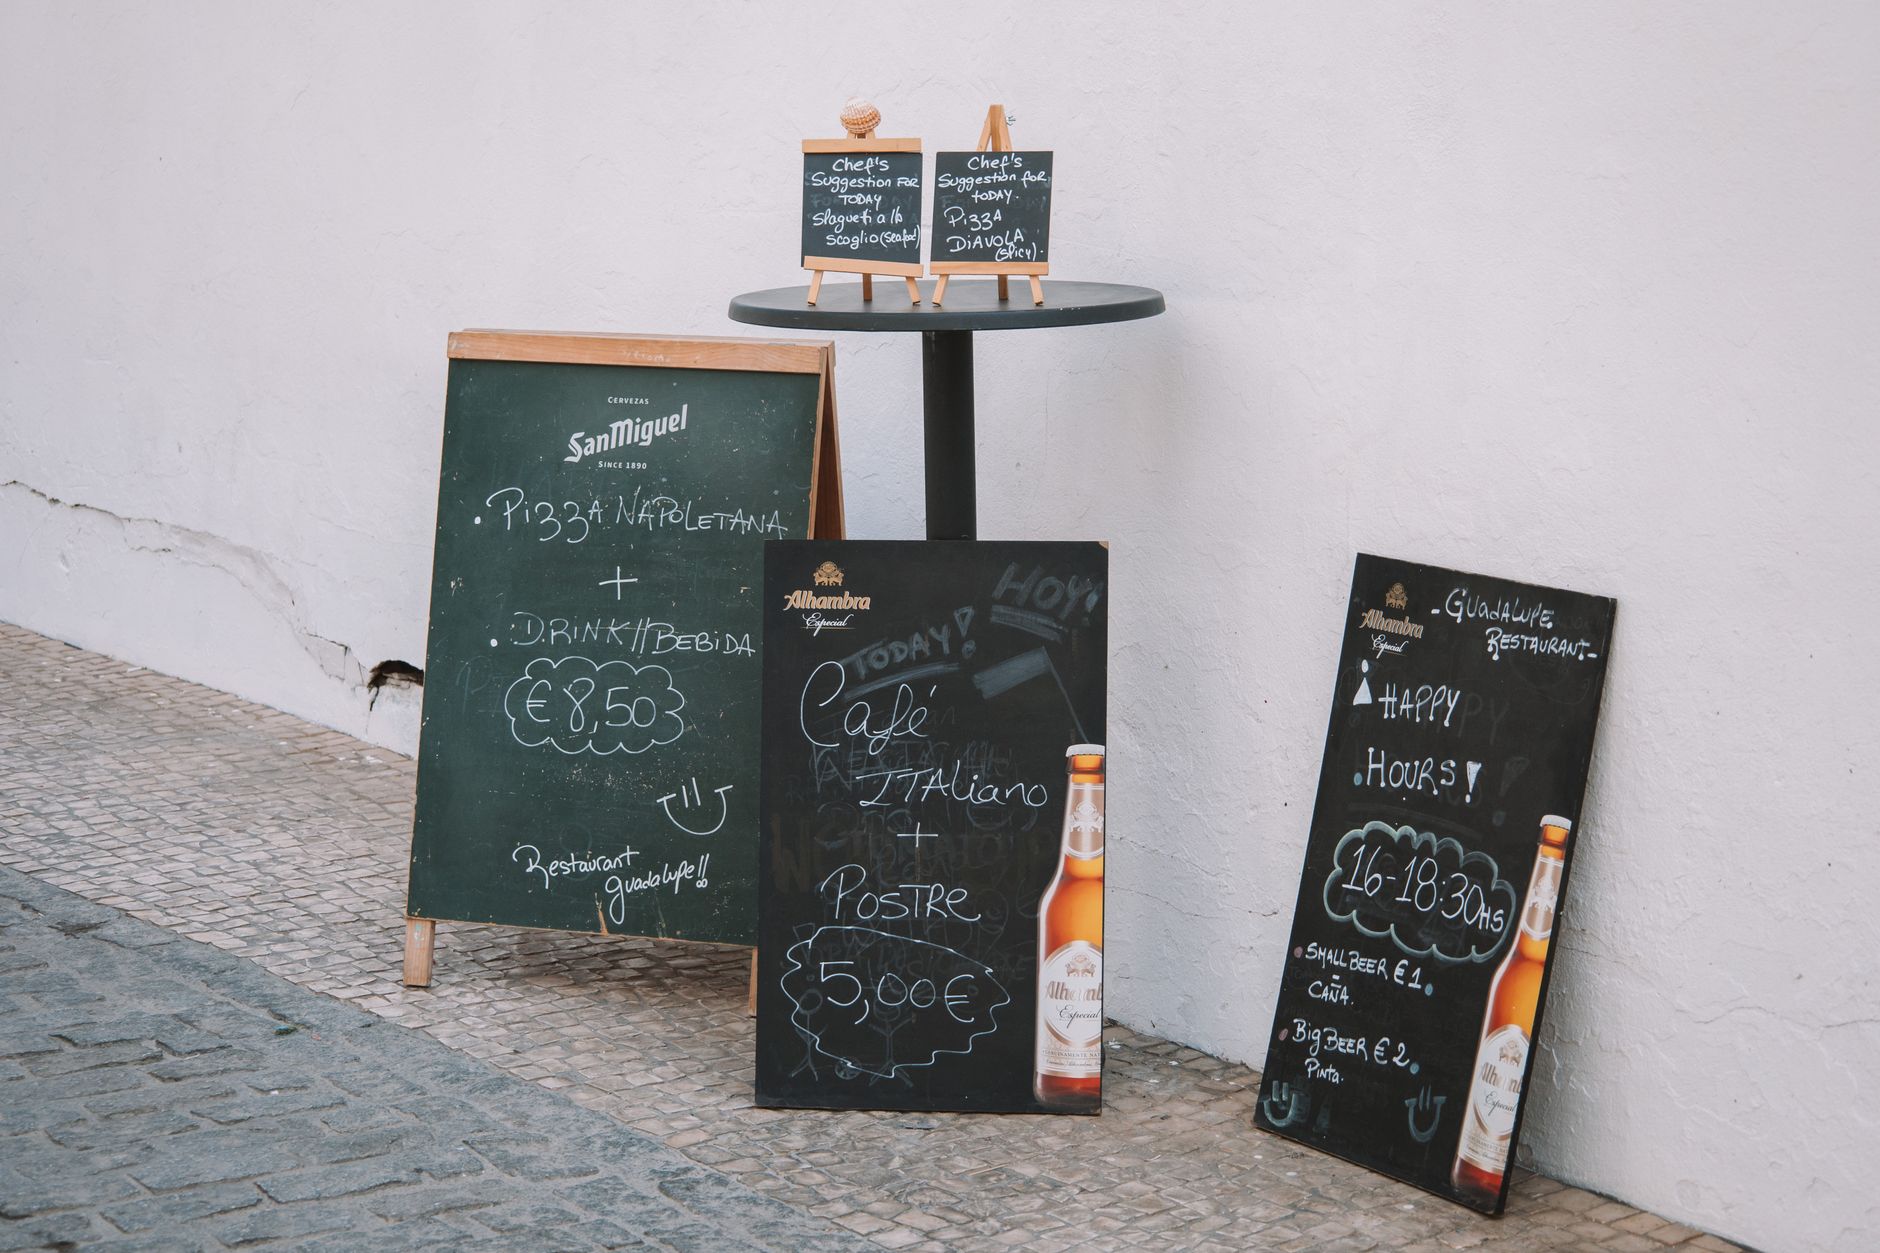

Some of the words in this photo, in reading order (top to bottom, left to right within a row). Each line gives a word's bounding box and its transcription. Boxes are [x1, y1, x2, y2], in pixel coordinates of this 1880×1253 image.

[832, 156, 890, 175] Chef's
[967, 152, 1023, 176] Chef's
[811, 171, 892, 193] Suggestion
[938, 171, 1016, 193] Suggestion
[838, 193, 882, 211] TODAY
[607, 396, 650, 405] CERVEZAS
[598, 460, 624, 469] SINCE
[625, 461, 648, 470] 1890
[783, 589, 871, 611] Alhambra
[802, 611, 855, 636] Especial
[1358, 608, 1424, 639] Alhambra
[1371, 633, 1409, 659] Especial
[800, 660, 938, 756] Café
[512, 845, 641, 890] Restaurant
[1305, 942, 1347, 969] SMALL
[1348, 950, 1388, 980] BEER
[1056, 1004, 1101, 1029] Especial
[1292, 1018, 1321, 1057] Big
[1323, 1027, 1368, 1061] BEER
